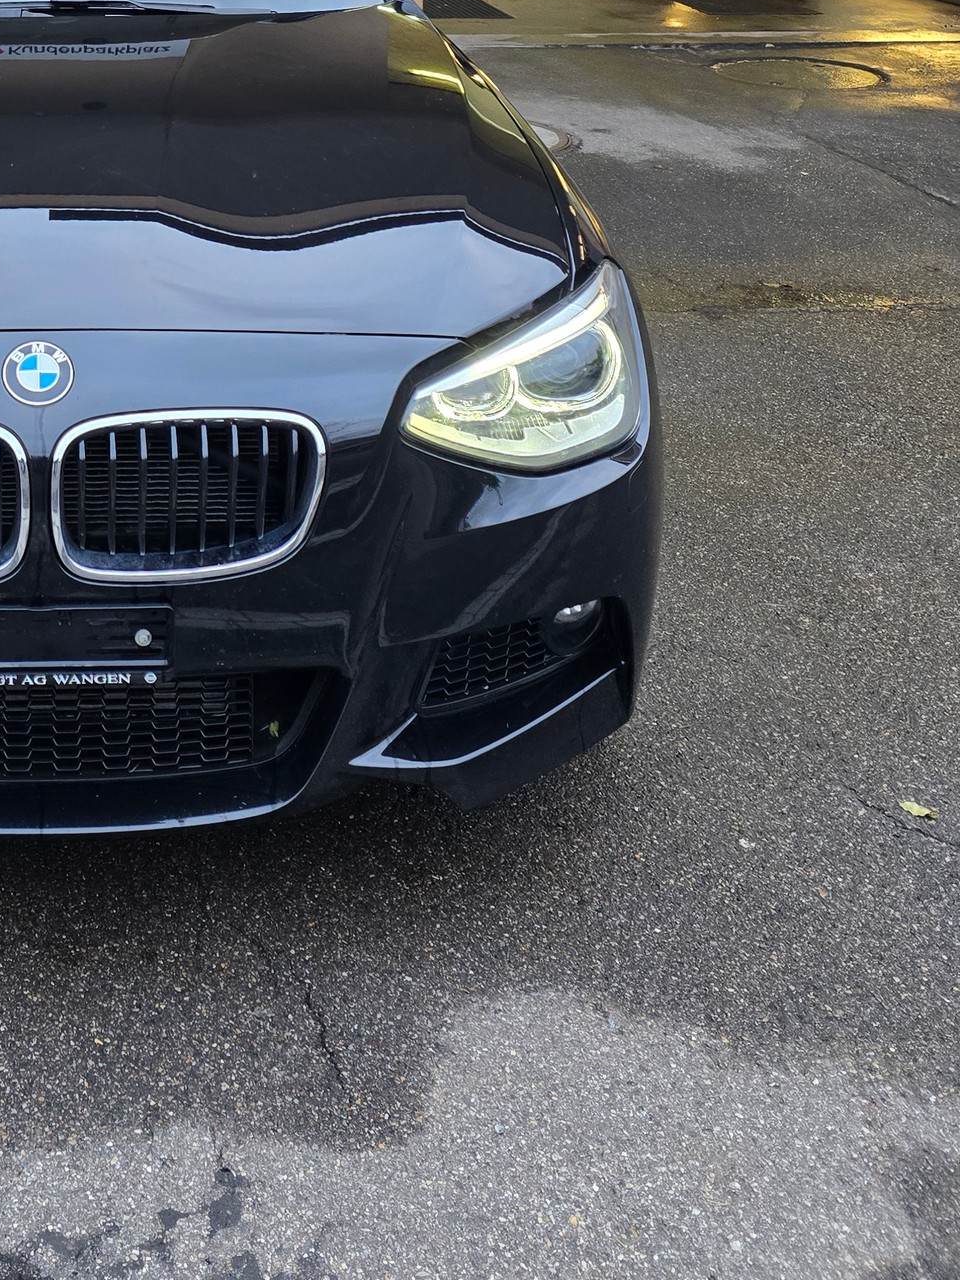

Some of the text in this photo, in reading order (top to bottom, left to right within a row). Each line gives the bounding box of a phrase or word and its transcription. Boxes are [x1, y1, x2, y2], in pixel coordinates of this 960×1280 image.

[10, 343, 67, 363] BMW
[21, 674, 48, 686] AG
[53, 673, 132, 686] WANGEN
